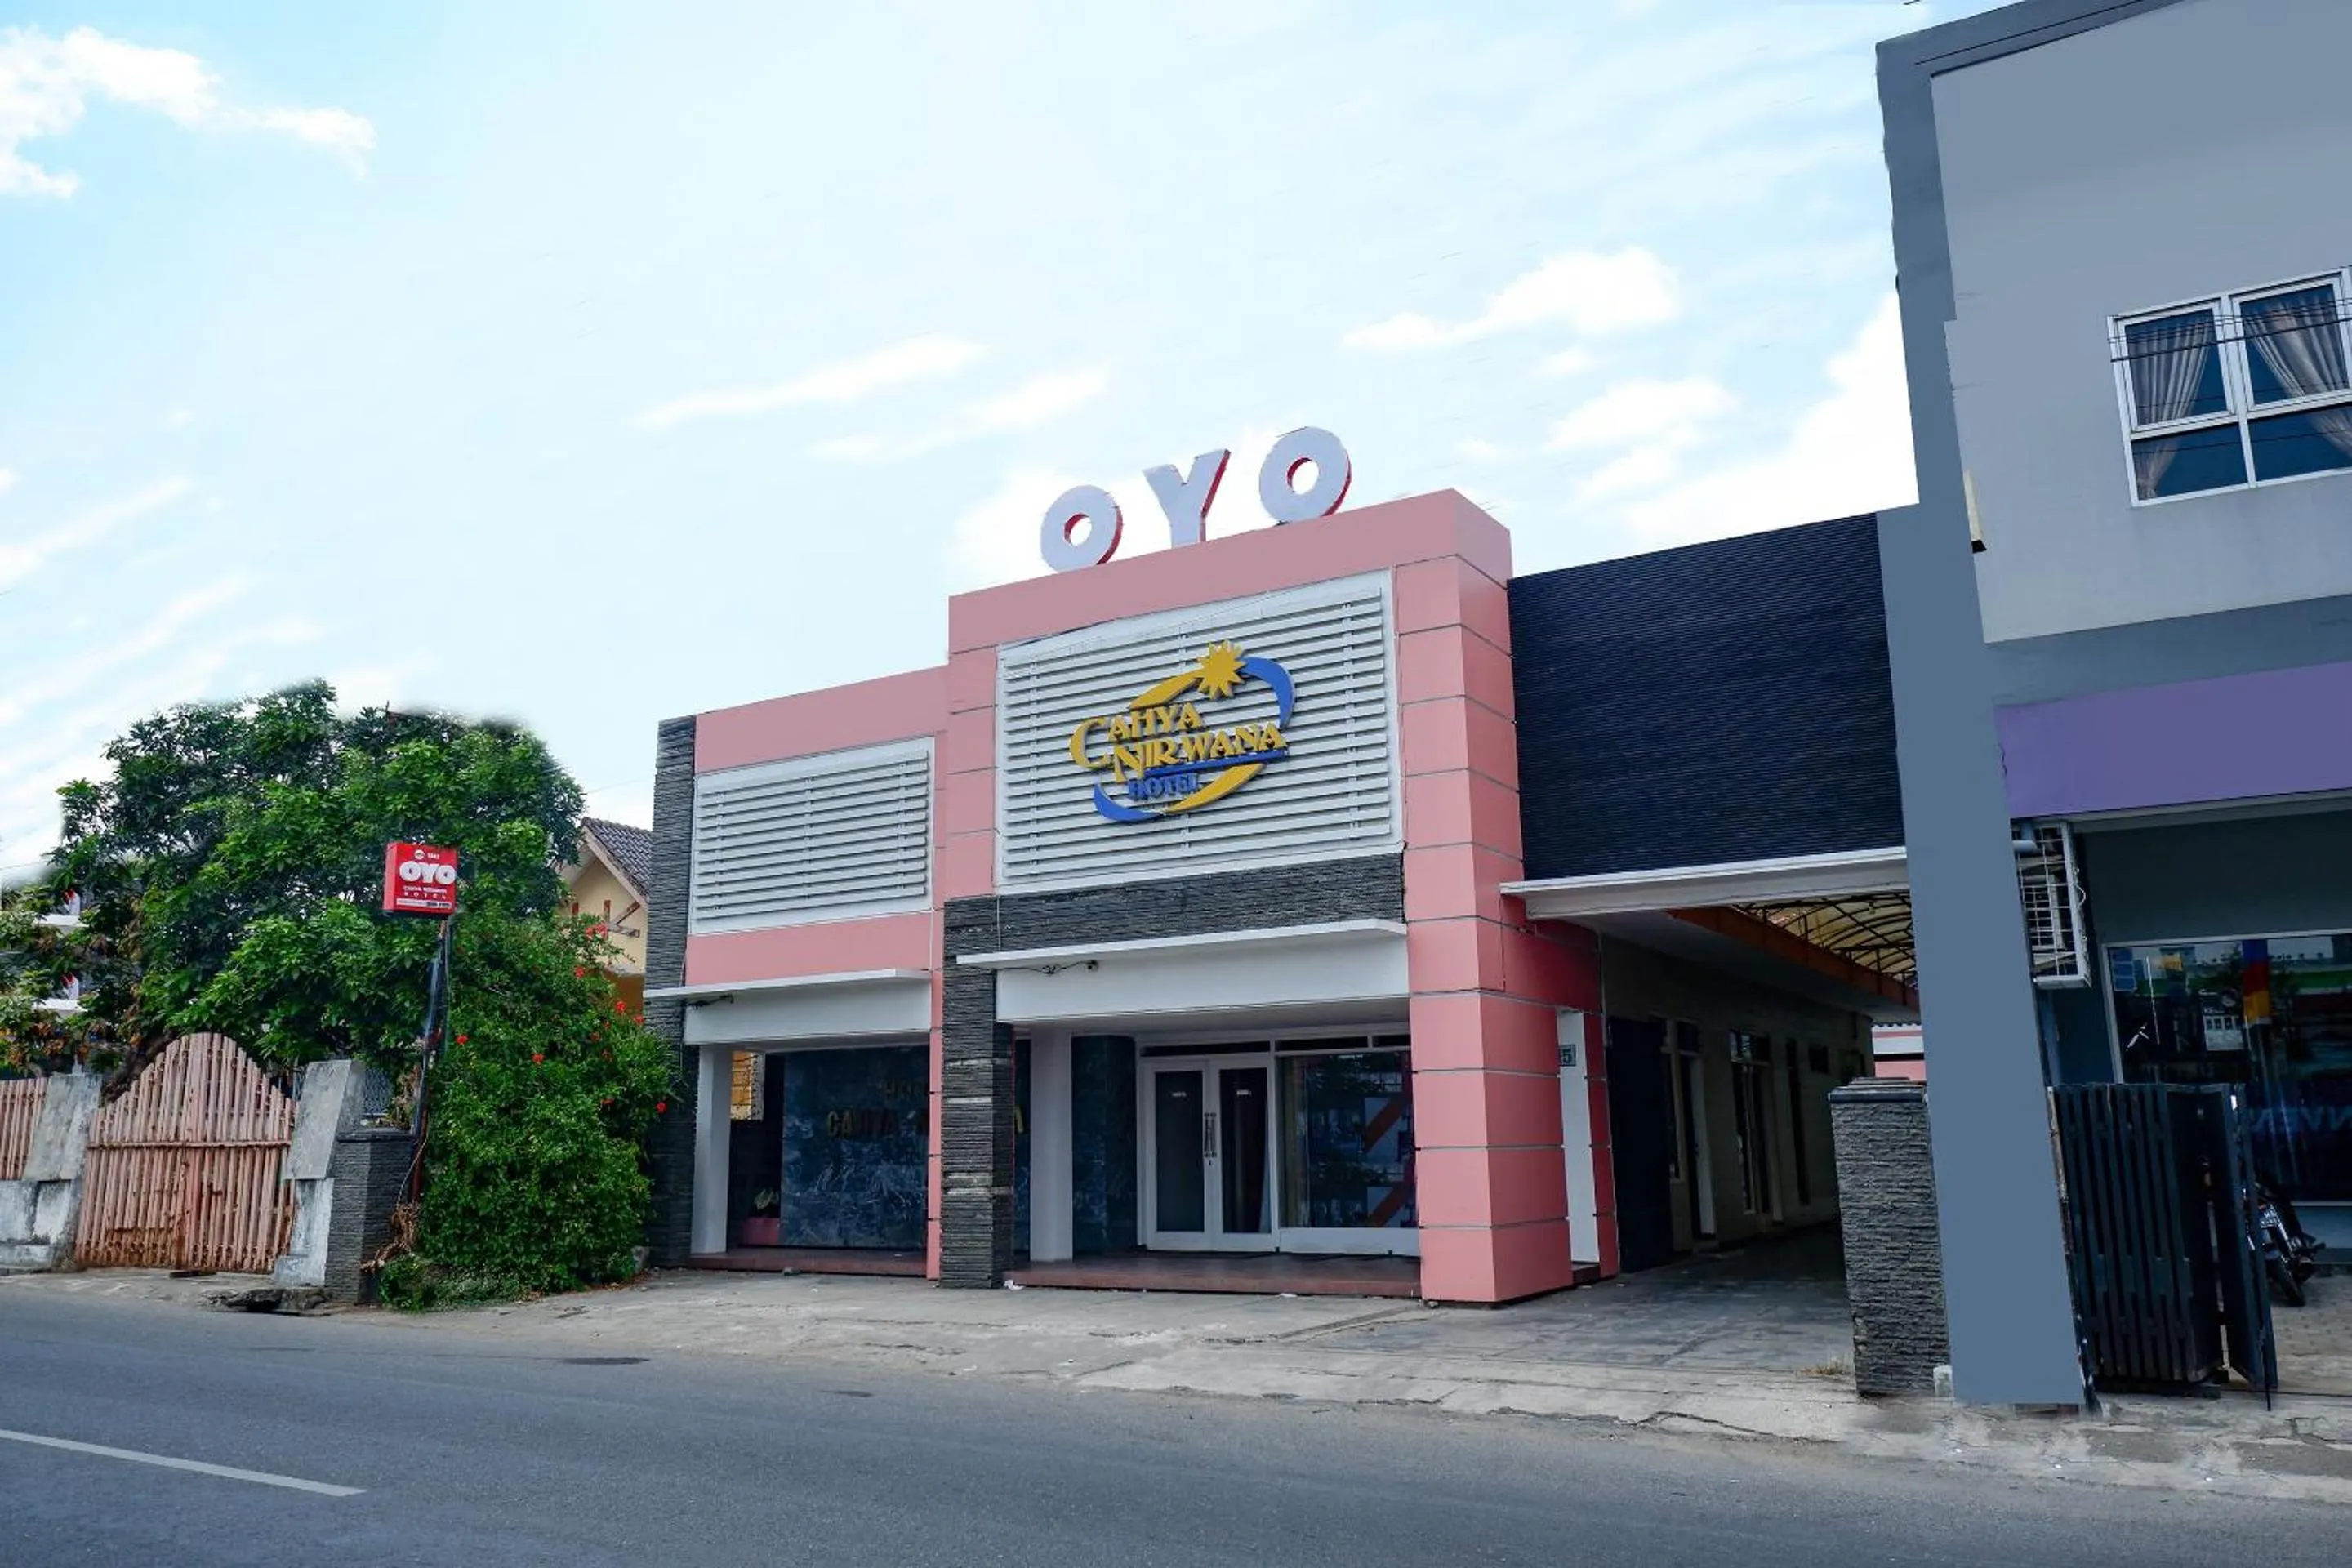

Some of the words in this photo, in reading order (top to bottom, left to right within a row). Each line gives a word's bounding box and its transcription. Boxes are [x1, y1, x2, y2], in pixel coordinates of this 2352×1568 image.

[1040, 426, 1352, 573] OYO
[1068, 702, 1205, 770] CAHYA
[1114, 722, 1288, 782] NIRWANA
[1129, 773, 1199, 800] HOTEL
[399, 861, 456, 884] OYO
